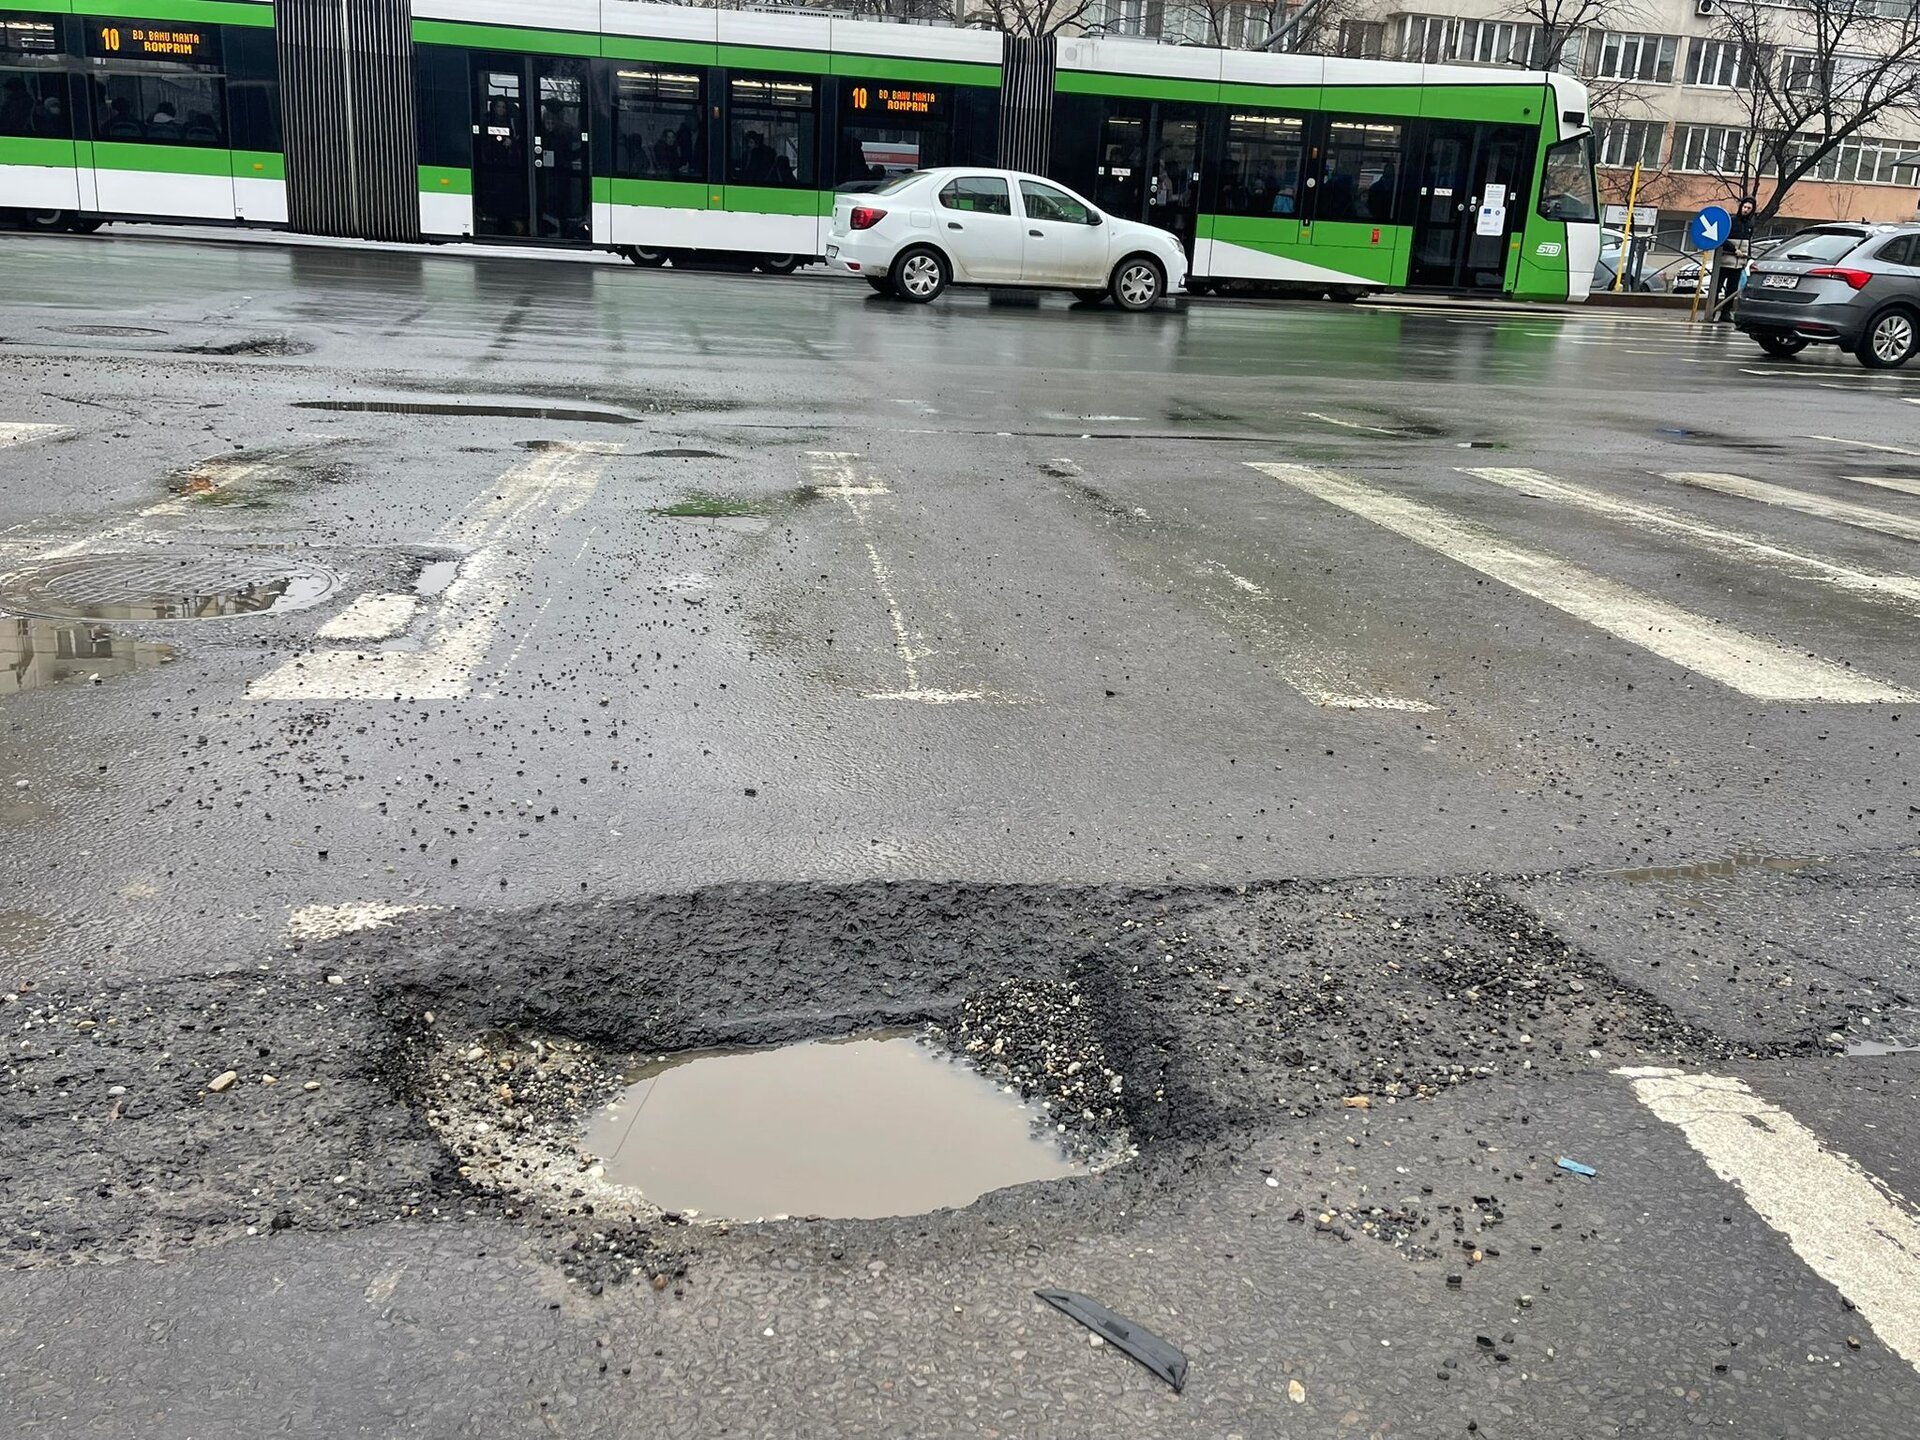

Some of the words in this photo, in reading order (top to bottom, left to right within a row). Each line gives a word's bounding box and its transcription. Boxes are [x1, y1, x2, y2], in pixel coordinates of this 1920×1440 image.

[102, 28, 119, 50] 10
[132, 29, 147, 40] BD.
[172, 32, 199, 44] MANTA
[144, 41, 192, 54] ROMPRIM
[853, 88, 867, 109] 10
[887, 100, 928, 112] ROMPRIM
[1536, 243, 1560, 255] STB
